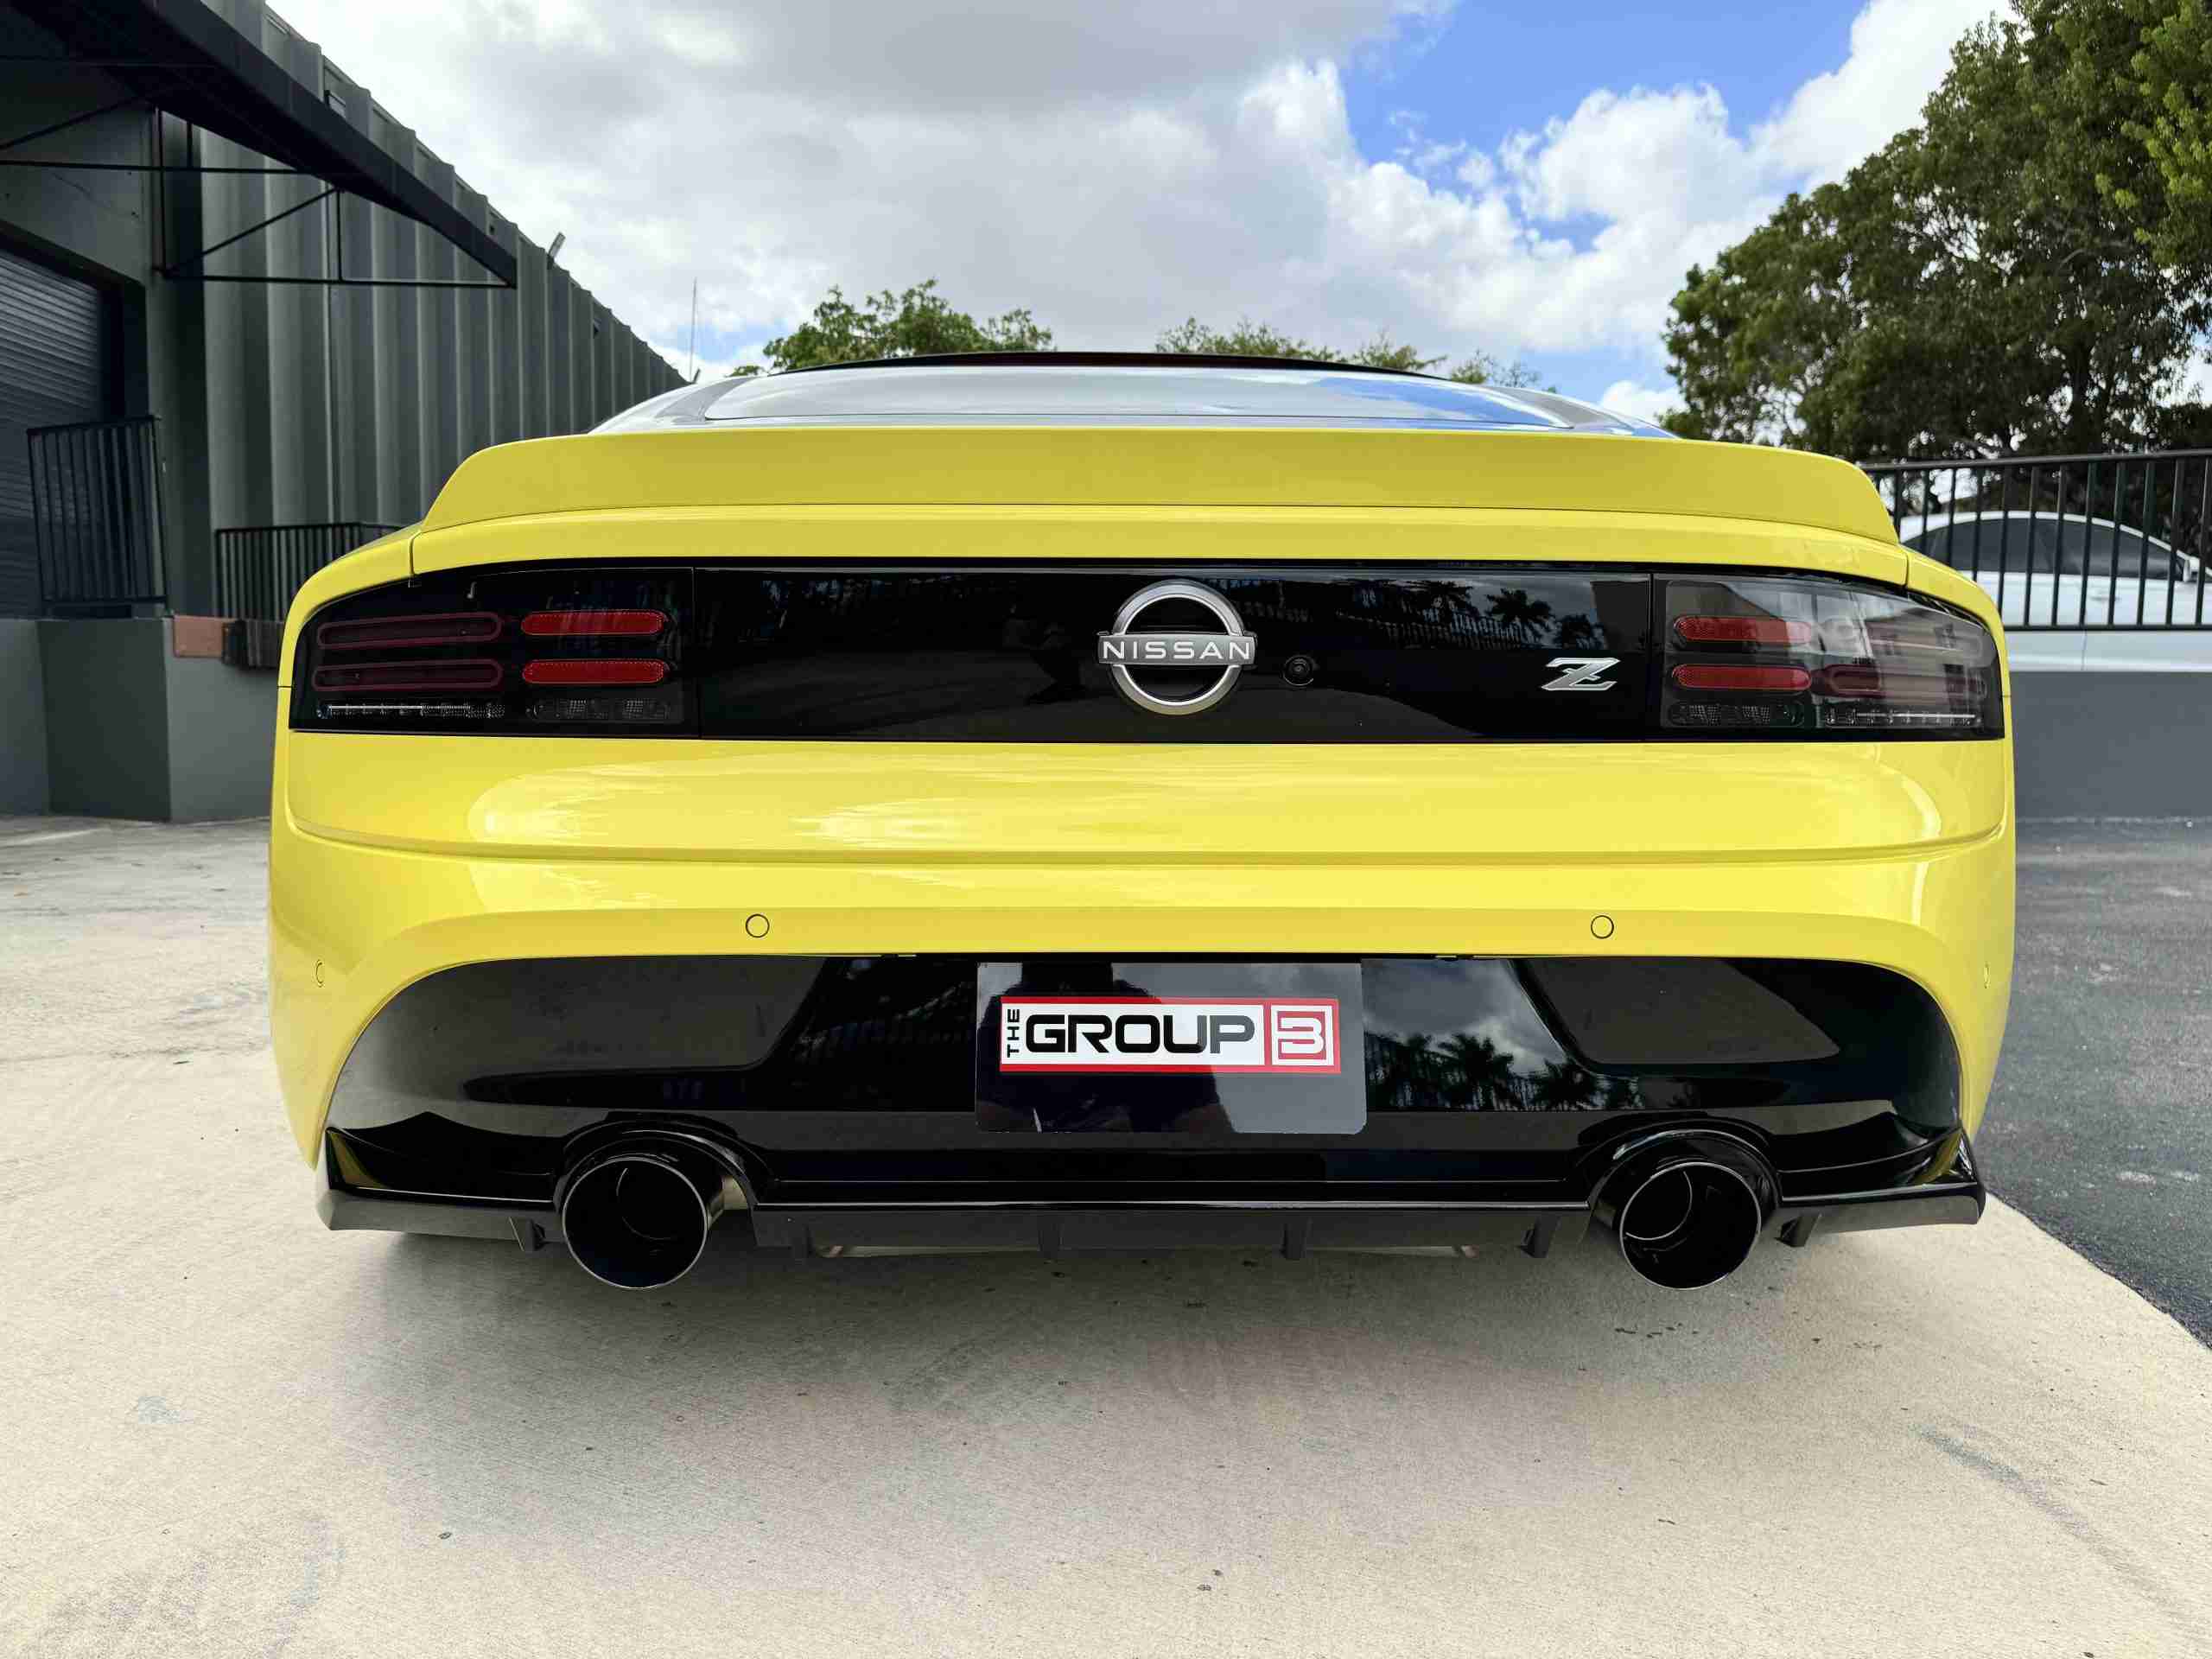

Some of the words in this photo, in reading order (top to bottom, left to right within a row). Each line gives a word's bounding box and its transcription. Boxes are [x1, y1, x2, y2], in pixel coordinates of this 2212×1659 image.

[1102, 641, 1249, 660] NISSAN
[1541, 657, 1621, 691] Z
[1007, 1008, 1020, 1058] THE
[1026, 1014, 1255, 1054] GROUP
[1279, 1014, 1325, 1056] 3
